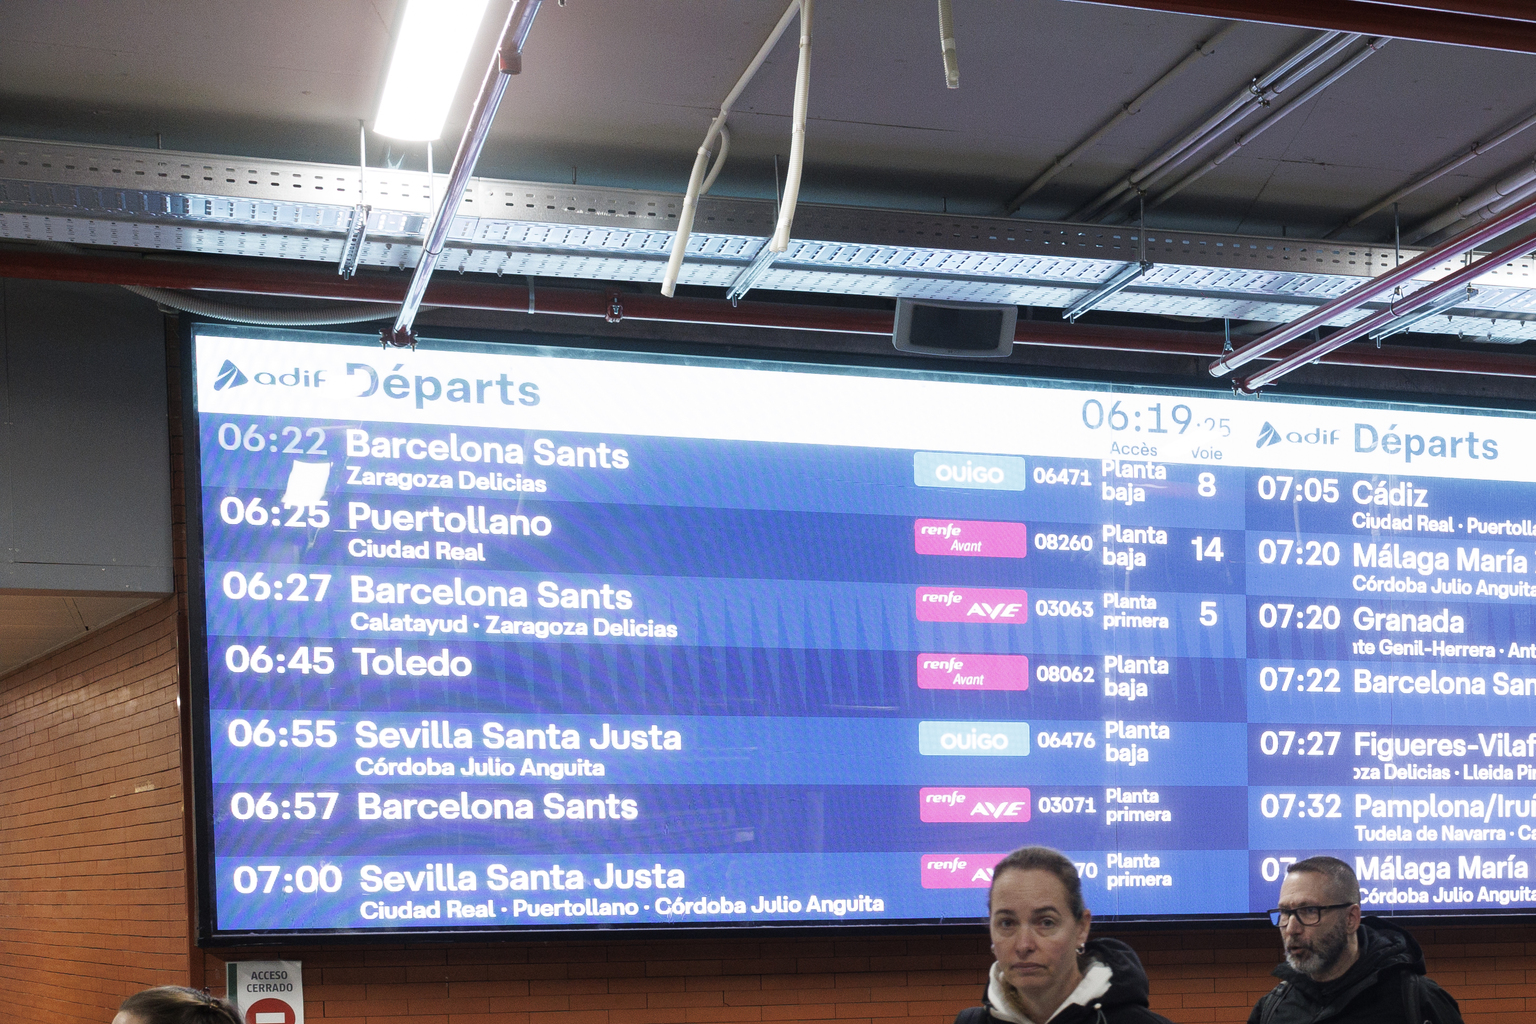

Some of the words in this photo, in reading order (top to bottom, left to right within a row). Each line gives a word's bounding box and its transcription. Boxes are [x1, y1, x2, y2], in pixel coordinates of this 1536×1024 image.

[255, 367, 328, 389] adif
[218, 422, 328, 456] 06:22
[346, 428, 524, 464] Barcelona
[534, 438, 629, 469] Sants
[1286, 428, 1341, 446] adif
[1355, 423, 1498, 463] Départs
[347, 466, 453, 490] Zaragoza
[459, 471, 547, 492] Delicias
[1033, 467, 1092, 486] 06471
[1198, 472, 1216, 497] 8
[1258, 476, 1339, 503] 07:05
[1352, 480, 1428, 507] Cádiz
[219, 497, 331, 530] 06:25
[349, 502, 552, 536] Puertollano
[348, 539, 429, 559] Ciudad
[436, 541, 486, 561] Real
[1035, 533, 1093, 551] 08260
[1191, 536, 1224, 561] 14
[1259, 539, 1340, 566] 07:20
[1354, 543, 1449, 575] Málaga
[1457, 547, 1527, 573] María
[223, 571, 331, 601] 06:27
[351, 575, 527, 607] Barcelona
[538, 581, 633, 609] Sants
[1036, 600, 1093, 617] 03063
[1259, 603, 1340, 629] 07:20
[1353, 607, 1464, 633] Granada
[351, 612, 467, 636] Calatayud
[485, 615, 588, 638] Zaragoza
[594, 618, 677, 637] Delicias
[226, 645, 334, 674] 06:45
[352, 648, 472, 676] Toledo
[1037, 666, 1094, 682] 08062
[1260, 667, 1340, 692] 07:22
[1355, 669, 1485, 695] Barcelona
[228, 719, 337, 747] 06:55
[355, 720, 472, 748] Sevilla
[483, 722, 580, 749] Santa
[590, 723, 681, 750] Justa
[1037, 732, 1095, 748] 06476
[1261, 731, 1341, 755] 07:27
[355, 757, 455, 775] Córdoba
[460, 757, 515, 776] Julio
[520, 758, 605, 780] Anguita
[231, 792, 339, 819] 06:57
[358, 792, 533, 819] Barcelona
[544, 793, 638, 820] Sants
[1038, 797, 1096, 813] 03071
[1261, 794, 1341, 818] 07:32
[1354, 825, 1412, 841] Tudela
[1416, 825, 1438, 841] de
[1442, 825, 1506, 841] Navarra
[234, 863, 342, 893] 07:00
[360, 863, 476, 892] Sevilla
[487, 864, 584, 891] Santa
[594, 863, 685, 889] Justa
[1356, 856, 1450, 885] Málaga
[1459, 855, 1528, 879] María
[360, 900, 440, 919] Ciudad
[447, 900, 496, 918] Real
[513, 898, 639, 917] Puertollano
[655, 896, 746, 916] Córdoba
[751, 896, 802, 913] Julio
[806, 895, 884, 916] Anguita
[247, 983, 293, 992] CERRADO
[251, 970, 288, 980] ACCESO
